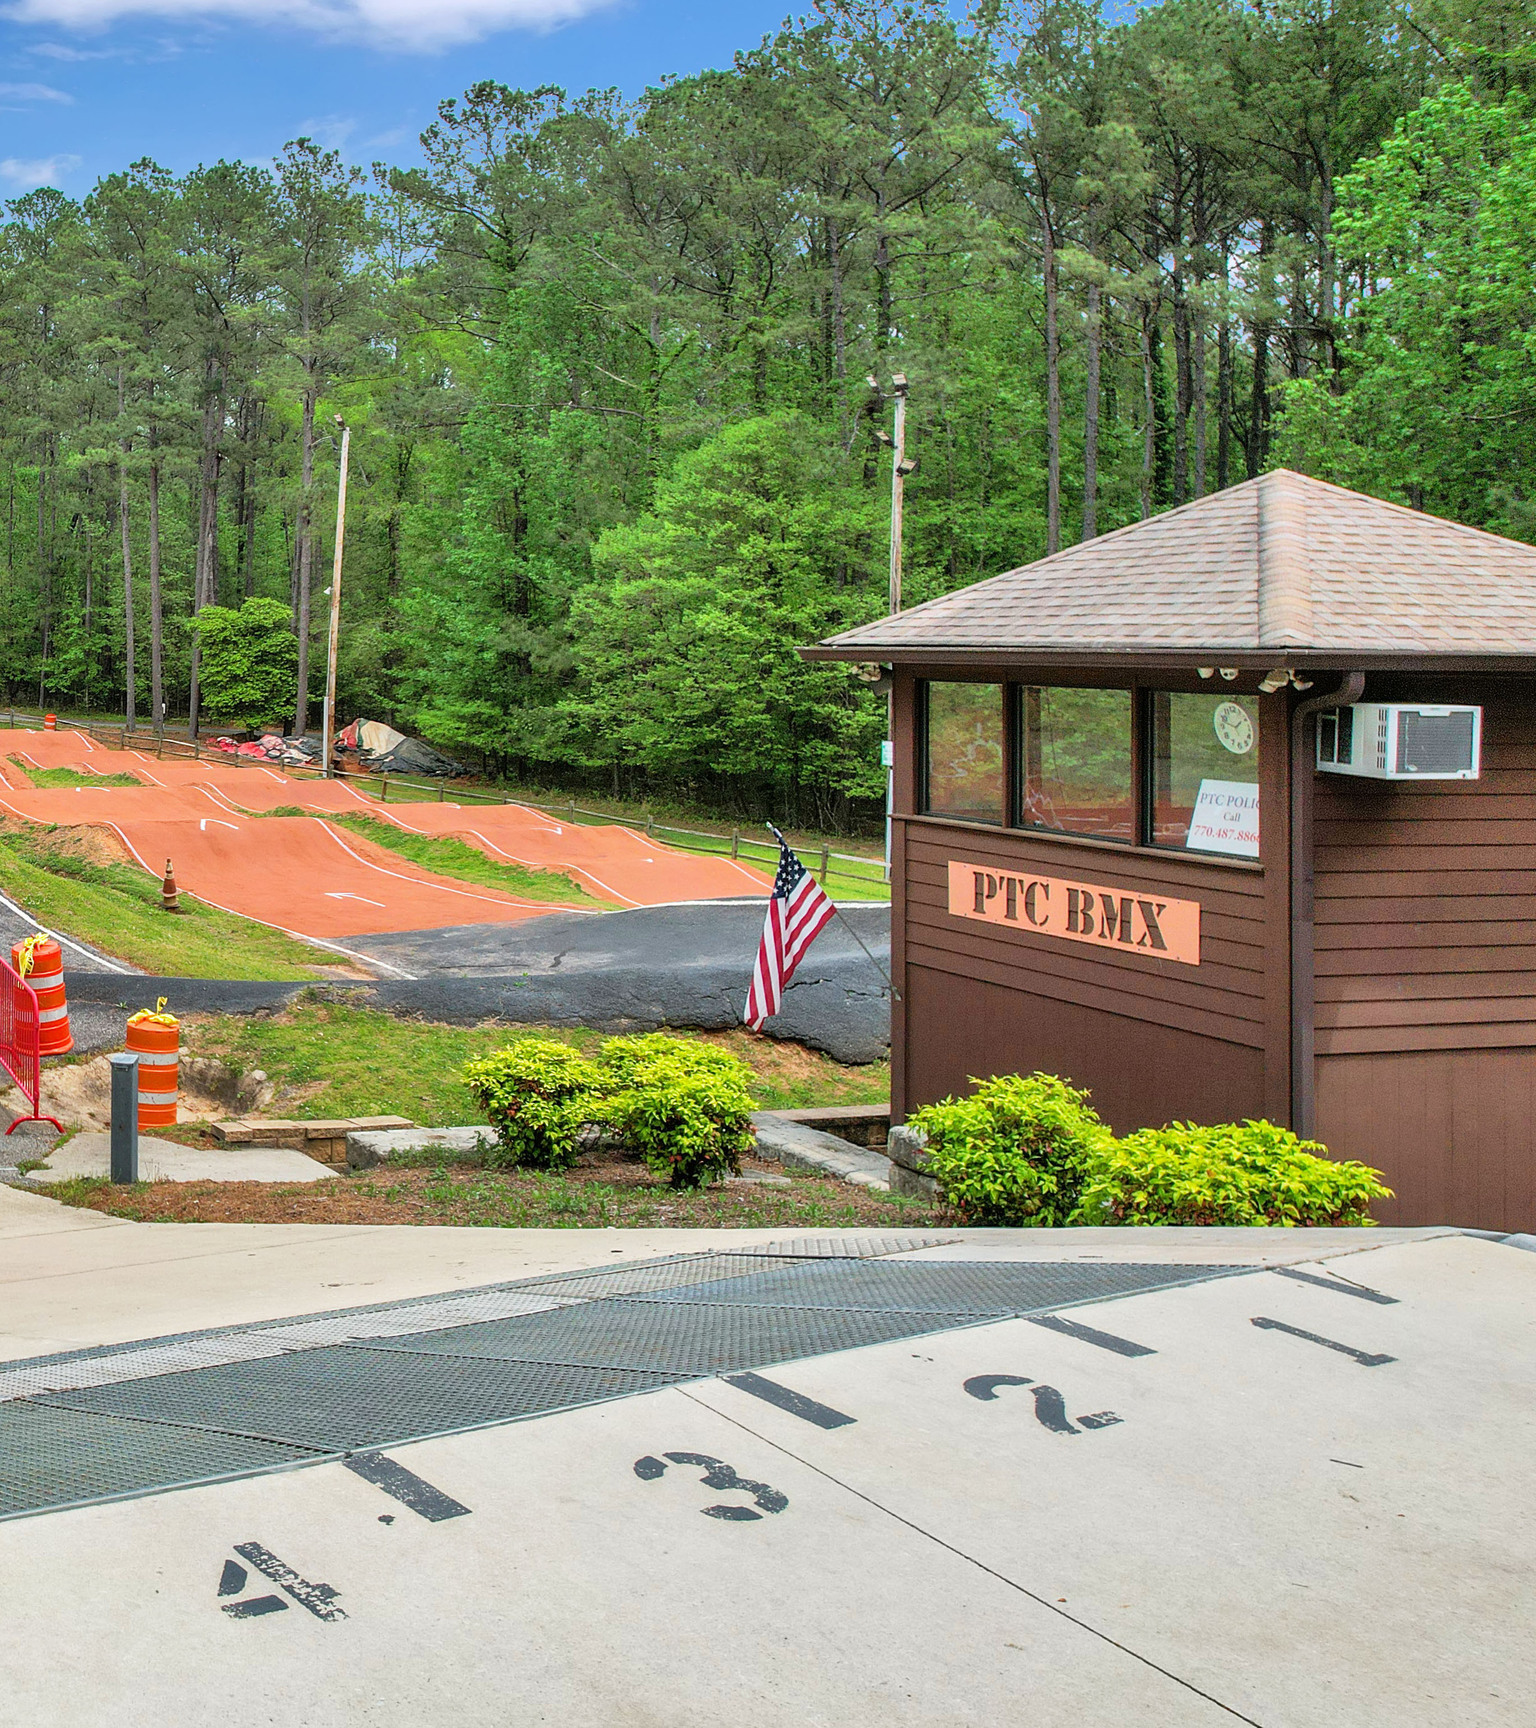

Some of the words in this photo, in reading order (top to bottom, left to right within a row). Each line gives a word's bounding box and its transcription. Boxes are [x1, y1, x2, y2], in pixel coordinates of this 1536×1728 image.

[1199, 792, 1225, 806] PTC
[1223, 811, 1241, 822] Call
[972, 871, 1050, 927] PTC
[1066, 887, 1168, 951] BMX
[1250, 1316, 1398, 1366] 1
[964, 1374, 1125, 1435] 2
[633, 1452, 789, 1521] 3
[217, 1541, 350, 1623] 4
